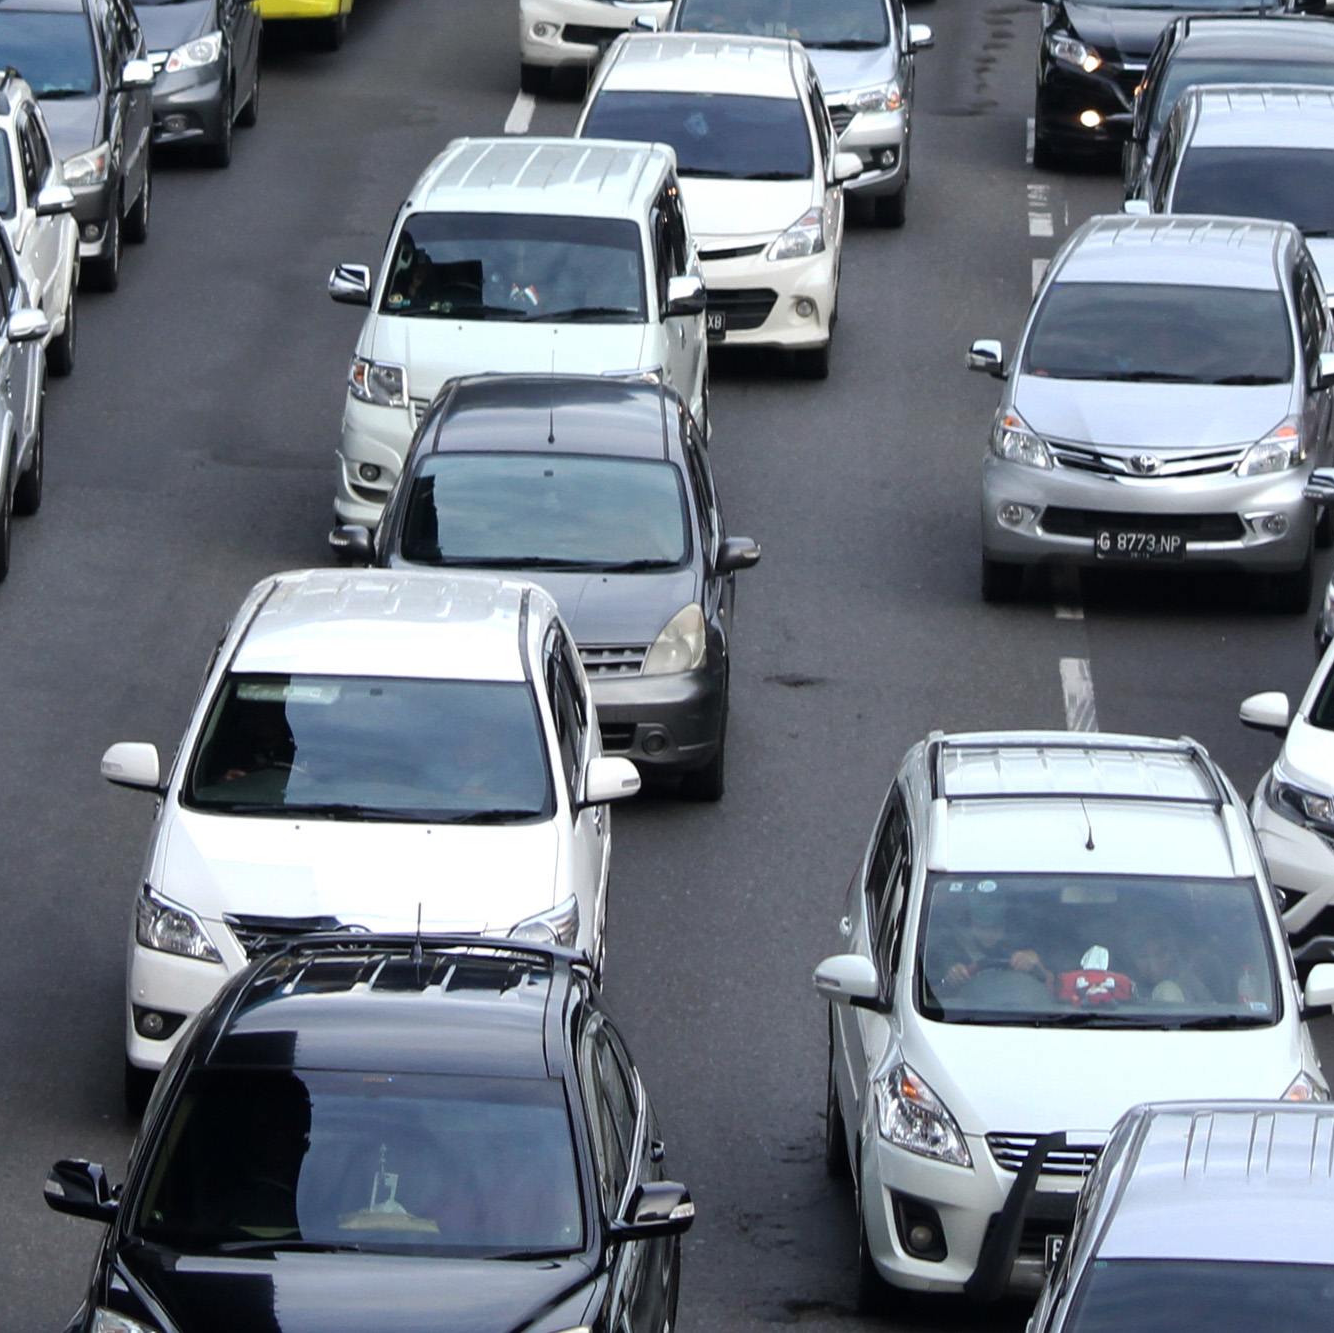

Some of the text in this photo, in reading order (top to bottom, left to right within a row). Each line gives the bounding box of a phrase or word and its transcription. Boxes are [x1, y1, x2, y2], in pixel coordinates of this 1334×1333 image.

[1100, 532, 1181, 553] G 8773 NP
